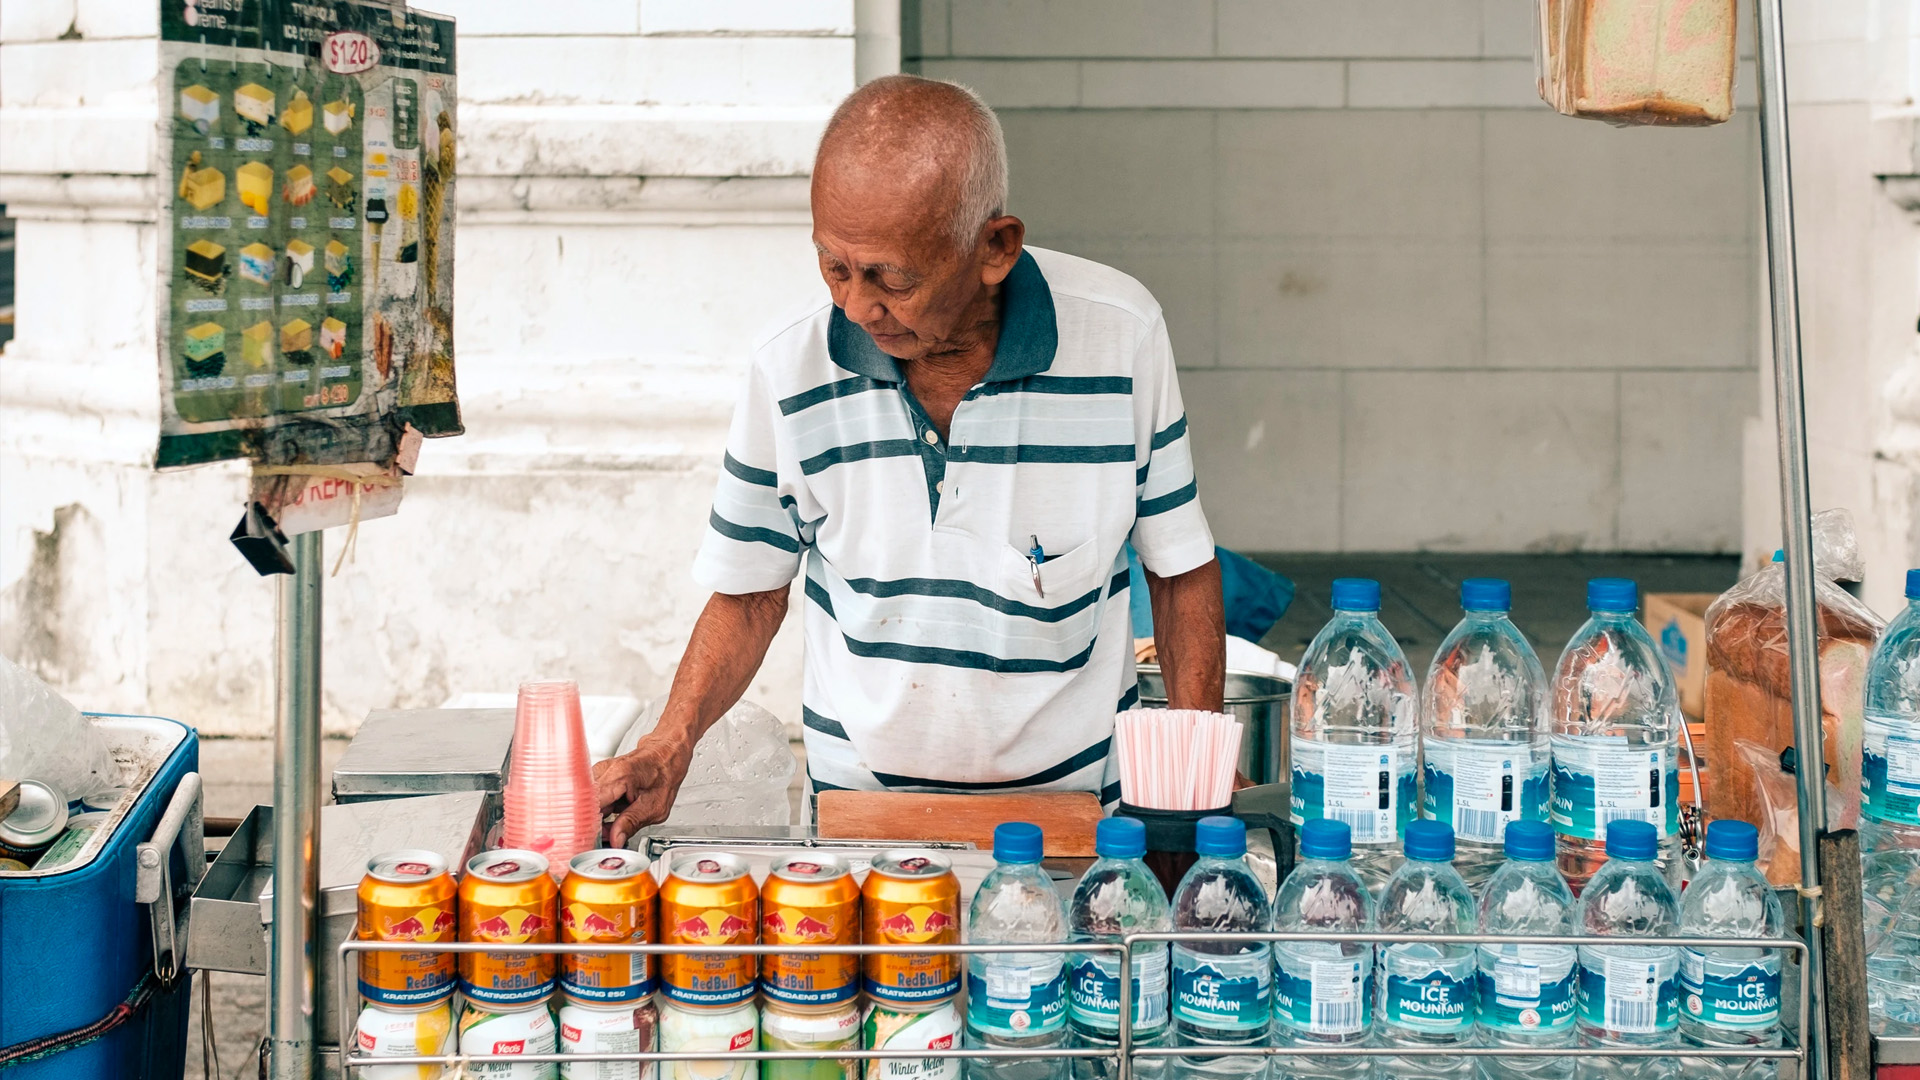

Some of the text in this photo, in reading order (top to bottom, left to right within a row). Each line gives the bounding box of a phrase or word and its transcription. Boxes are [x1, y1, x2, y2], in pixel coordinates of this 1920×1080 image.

[331, 39, 367, 66] $1.20
[492, 970, 537, 989] RedBull
[691, 972, 736, 990] RedBull
[897, 969, 942, 987] RedBull
[1080, 977, 1104, 996] ICE
[382, 983, 451, 1000] KRATINGDAENG
[471, 987, 542, 1000] KRATINGDAENG
[607, 990, 626, 998] 250
[671, 988, 741, 1001] KRATINGDAENG
[820, 992, 838, 1000] 250
[875, 986, 946, 998] KRATINGDAENG
[1193, 980, 1220, 997] ICE
[1420, 986, 1450, 1001] ICE
[1737, 983, 1766, 998] ICE
[1179, 991, 1240, 1012] MOUNTAIN
[1399, 998, 1464, 1016] MOUNTAIN
[1715, 996, 1778, 1012] MOUNTAIN
[498, 1043, 521, 1053] Yeo's
[888, 1058, 945, 1075] Winter Melon
